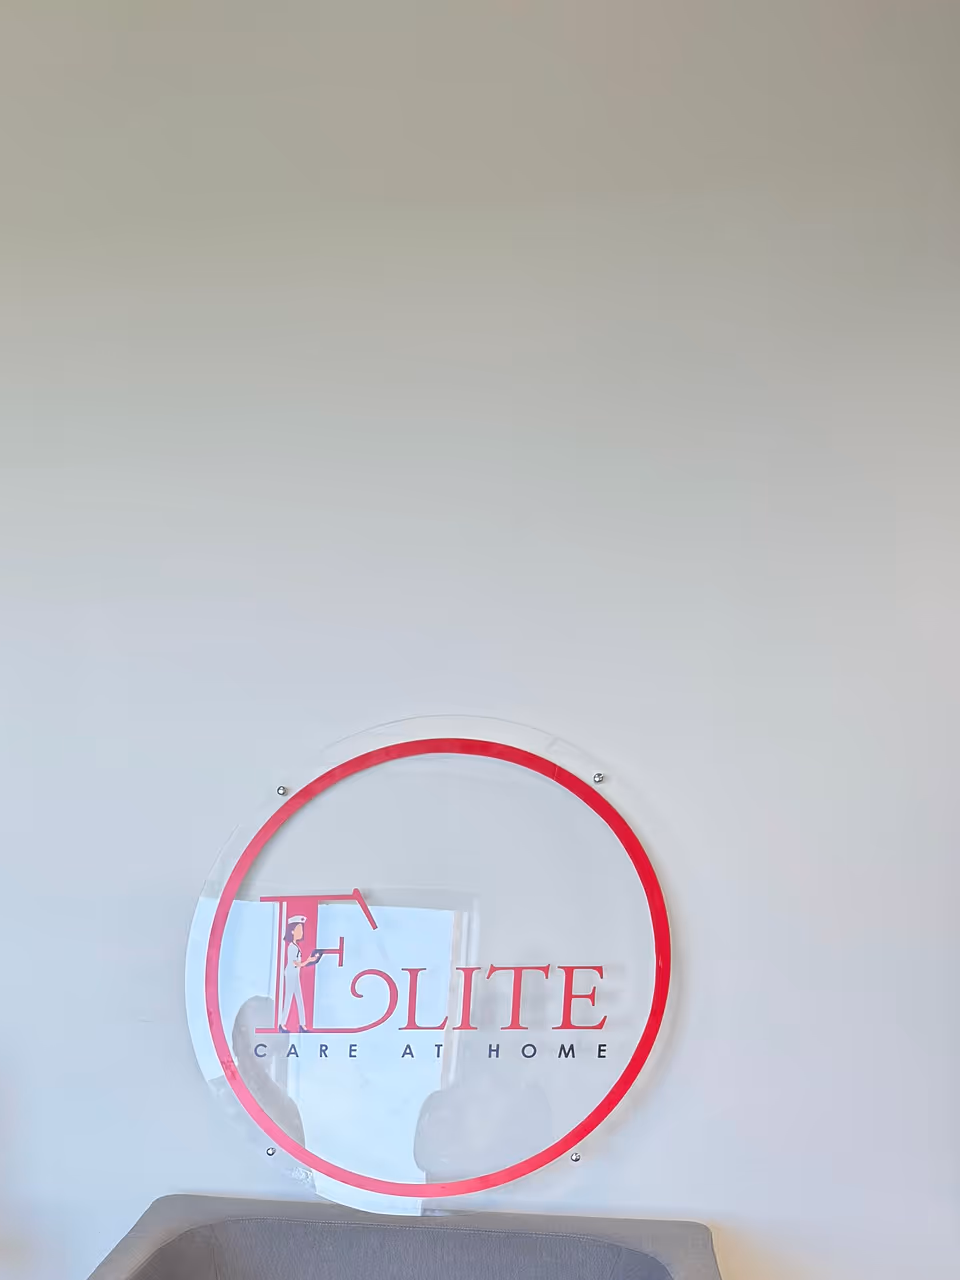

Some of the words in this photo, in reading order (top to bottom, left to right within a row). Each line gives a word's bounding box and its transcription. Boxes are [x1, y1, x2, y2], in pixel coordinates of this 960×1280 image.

[255, 888, 608, 1034] ELITE
[254, 1043, 358, 1059] CARE
[401, 1043, 443, 1059] AT
[488, 1043, 607, 1059] HOME
